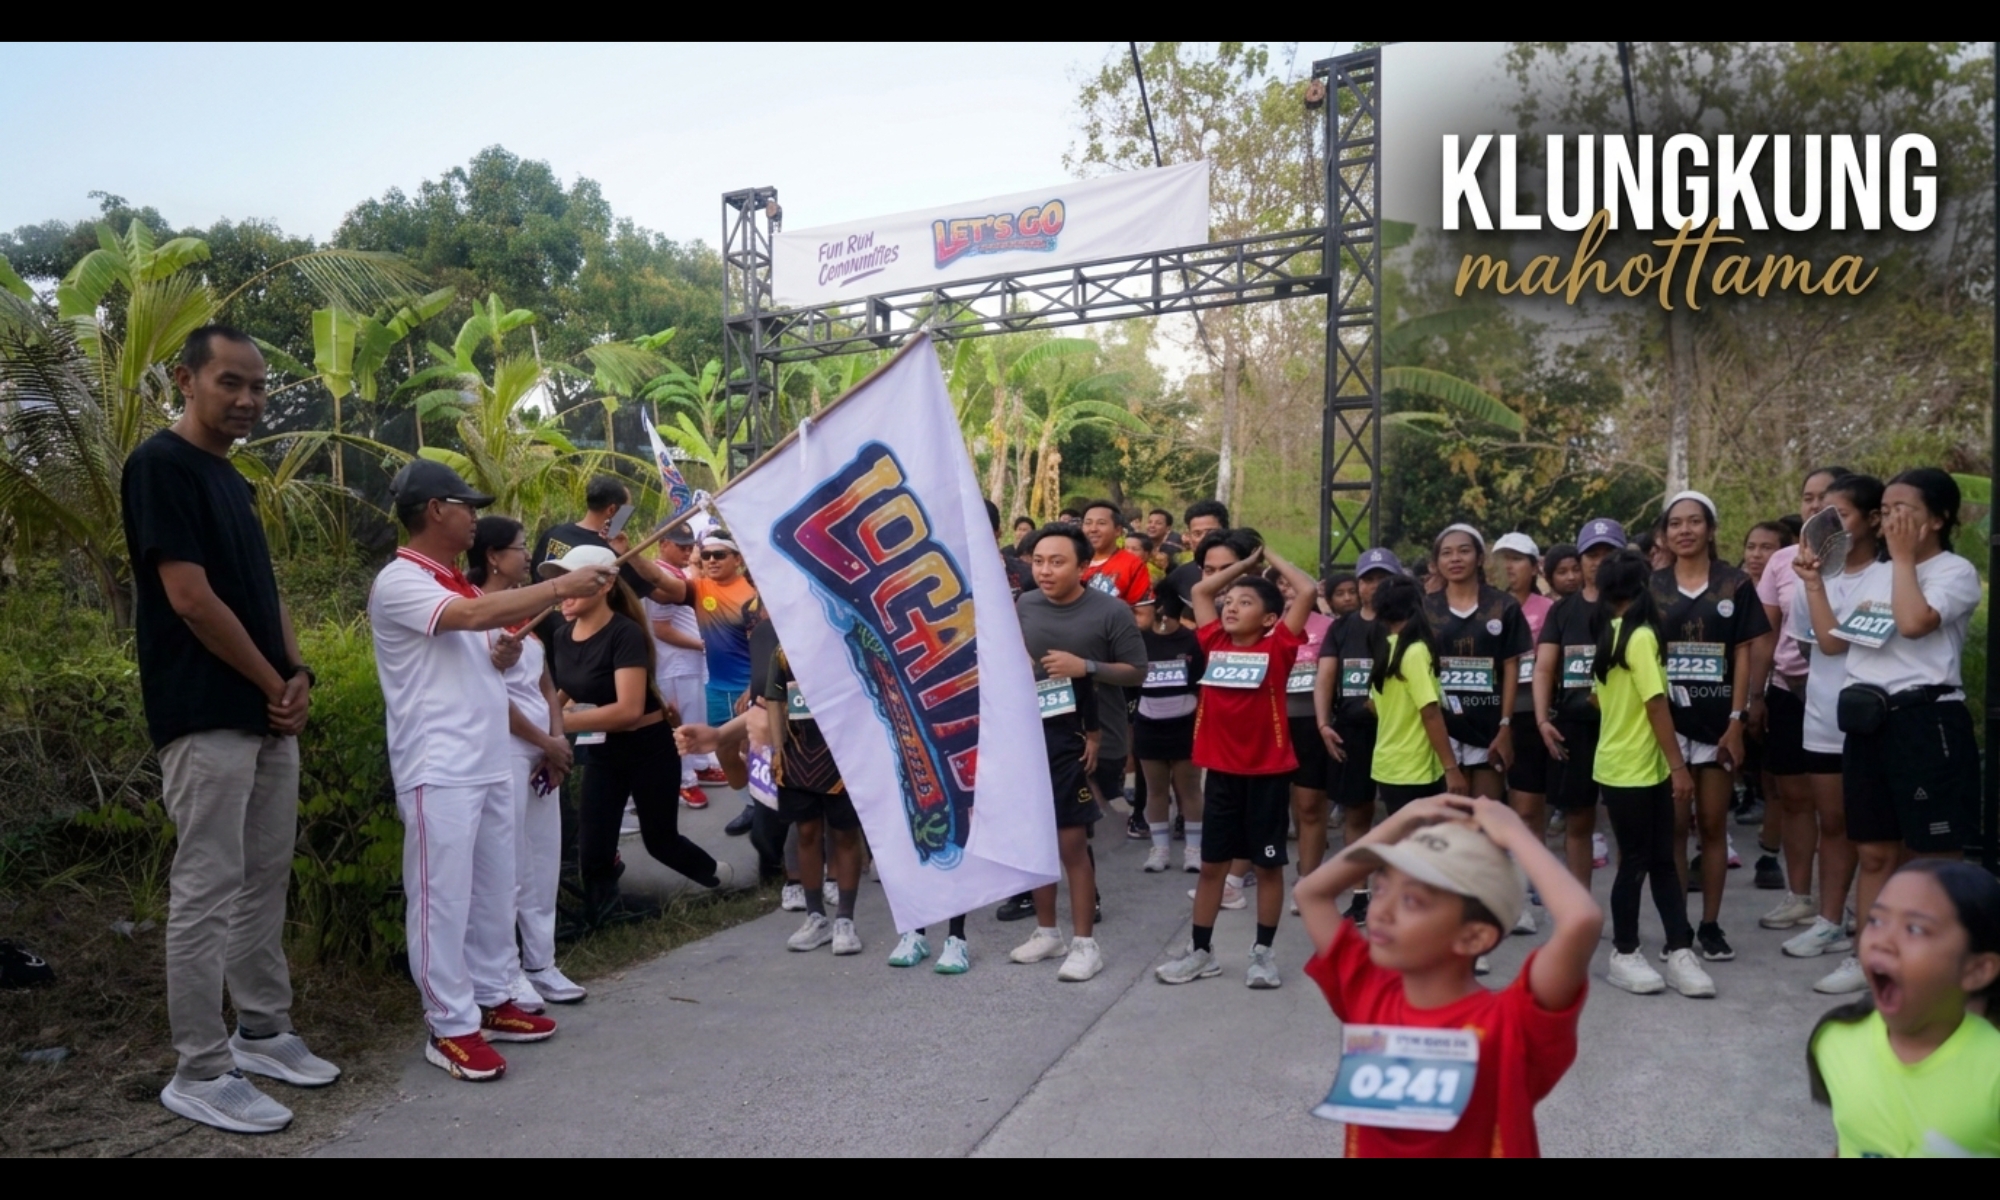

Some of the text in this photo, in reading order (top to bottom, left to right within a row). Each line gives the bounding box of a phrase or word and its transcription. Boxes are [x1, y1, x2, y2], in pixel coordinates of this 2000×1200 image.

[933, 199, 1064, 267] LET'S GO
[1350, 1064, 1461, 1104] 0241
